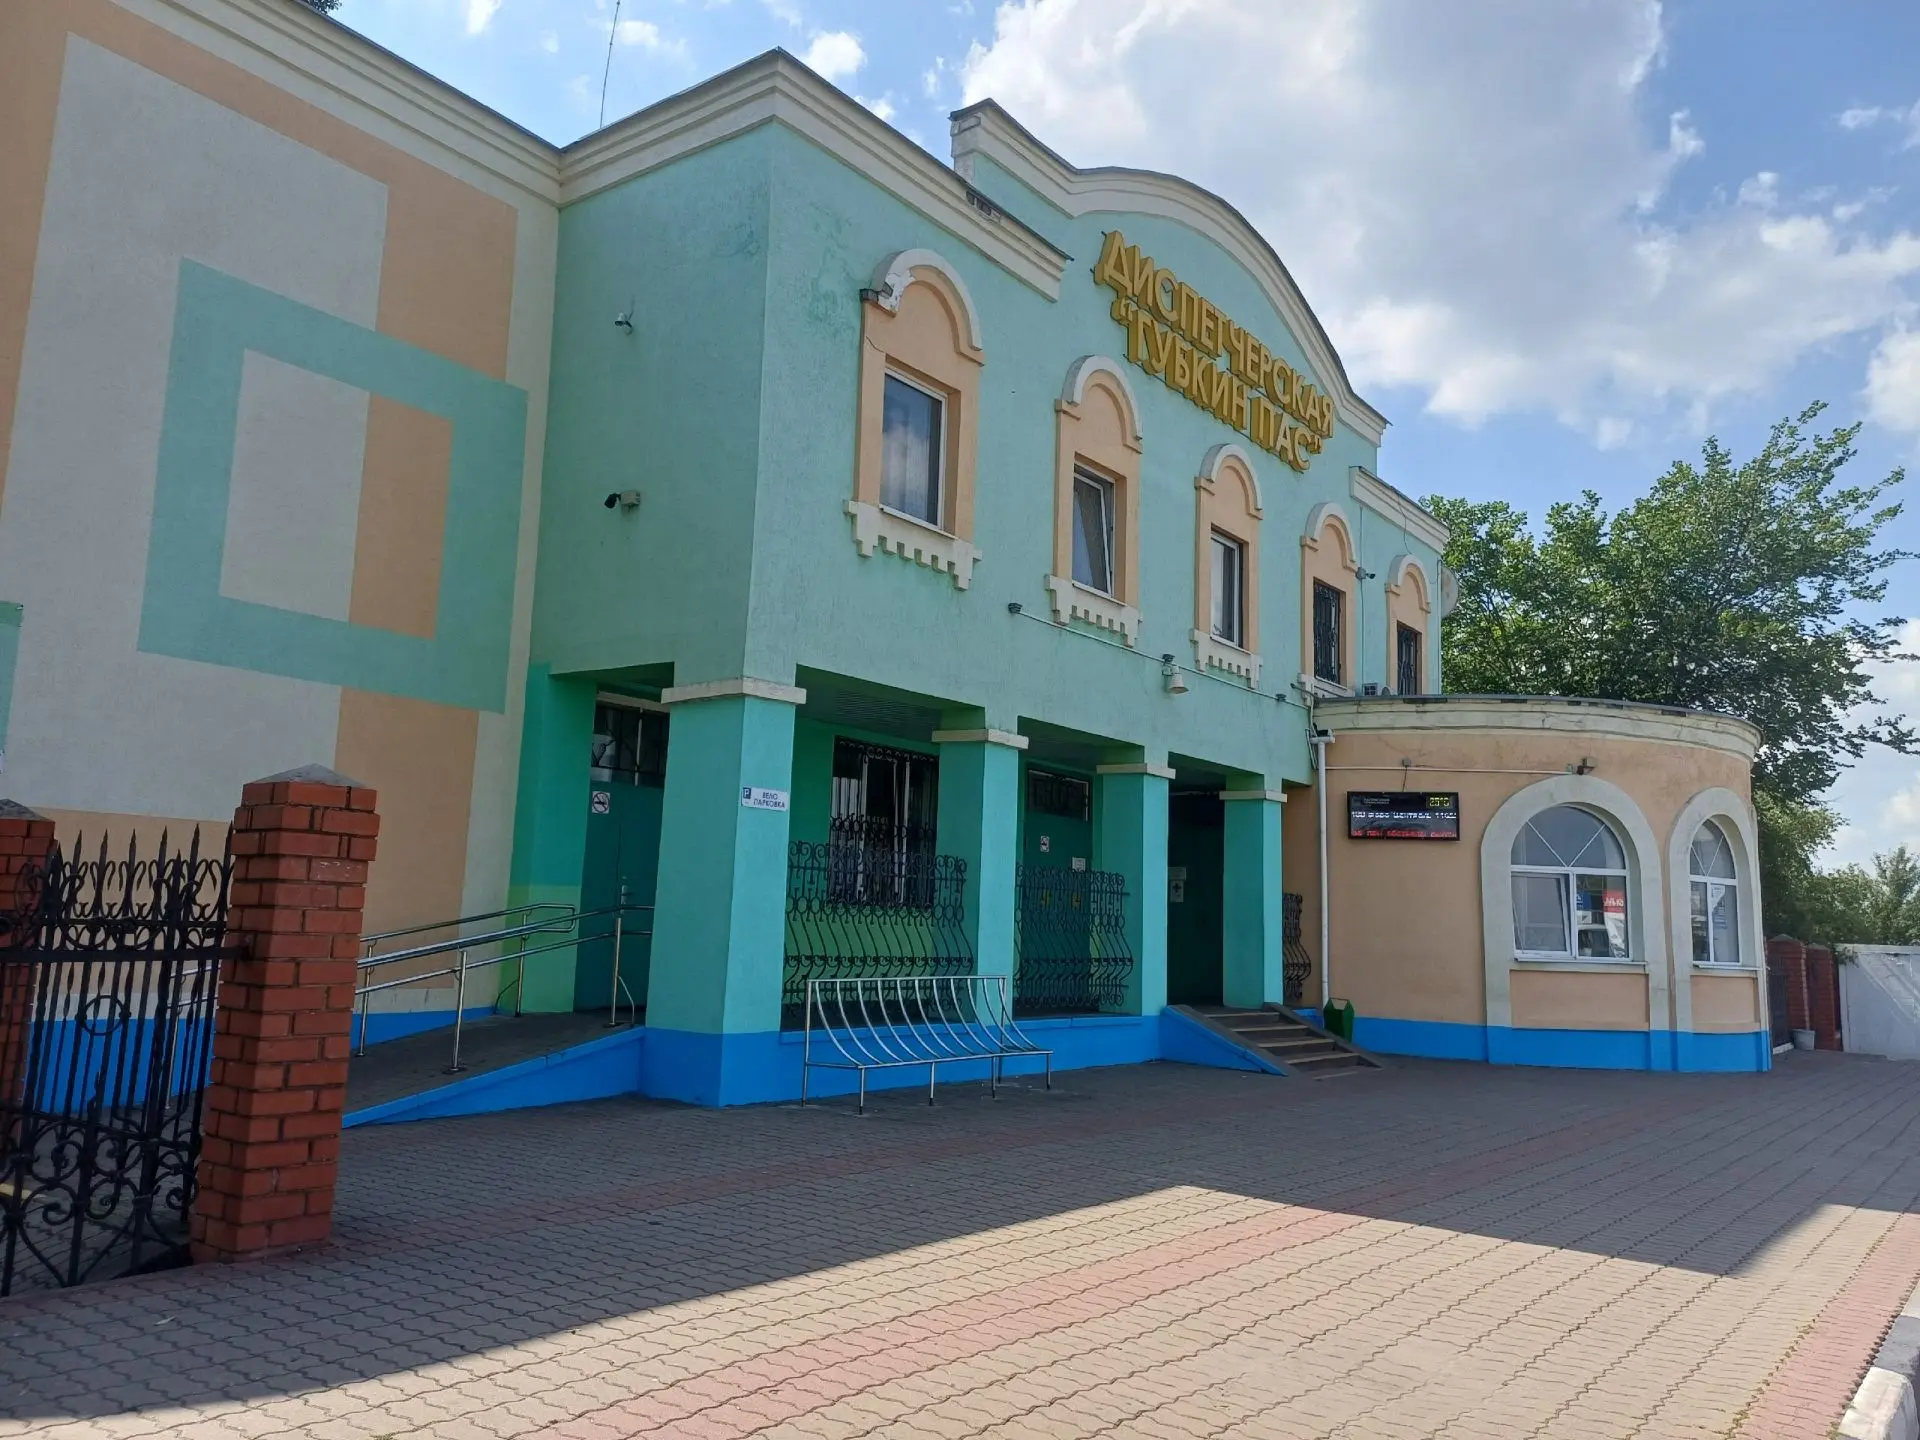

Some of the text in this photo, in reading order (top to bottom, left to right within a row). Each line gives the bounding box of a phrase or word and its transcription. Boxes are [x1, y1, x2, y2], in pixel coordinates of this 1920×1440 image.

[1094, 230, 1334, 438] ДИСПЕТЧЕРСКАЯ
[762, 791, 778, 800] ВЕЛО
[753, 798, 786, 809] ПАРКОВКА
